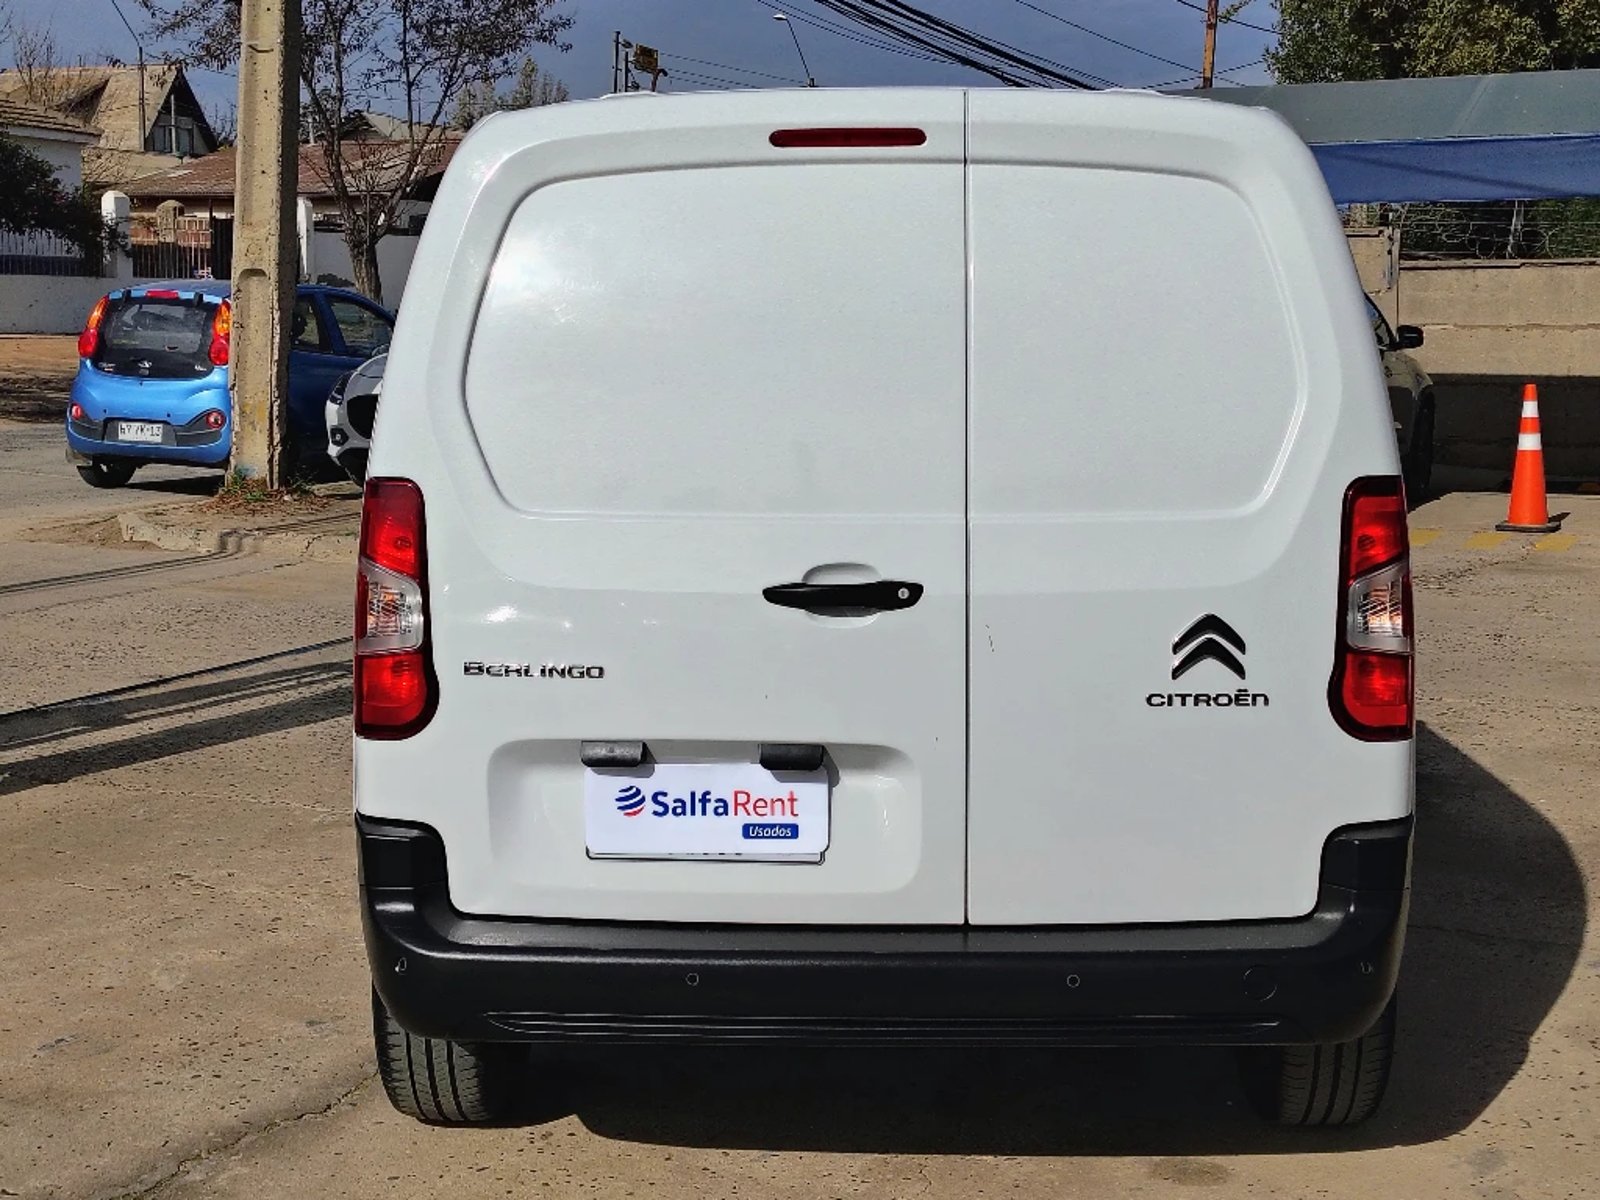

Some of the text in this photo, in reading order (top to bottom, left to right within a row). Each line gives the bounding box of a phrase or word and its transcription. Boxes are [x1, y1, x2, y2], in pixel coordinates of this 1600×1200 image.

[463, 661, 605, 679] BERLINGO
[1146, 688, 1269, 707] CITROËN
[651, 790, 799, 817] SalfaRent
[749, 826, 792, 838] Usados
